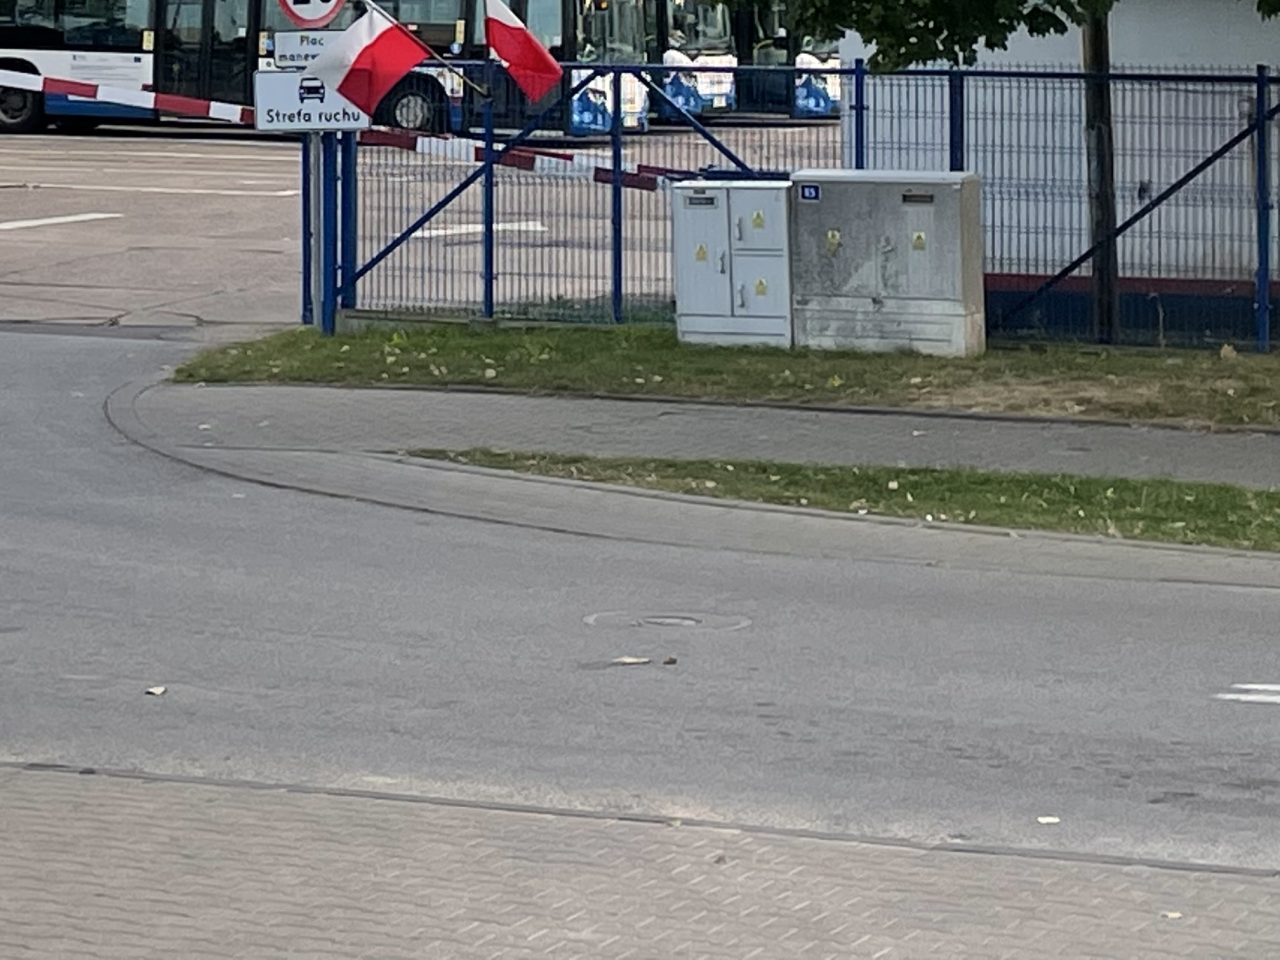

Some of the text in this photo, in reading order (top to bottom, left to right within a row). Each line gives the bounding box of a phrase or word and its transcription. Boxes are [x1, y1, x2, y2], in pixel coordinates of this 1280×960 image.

[300, 35, 324, 47] Plac
[266, 107, 361, 123] Strefa ruchu
